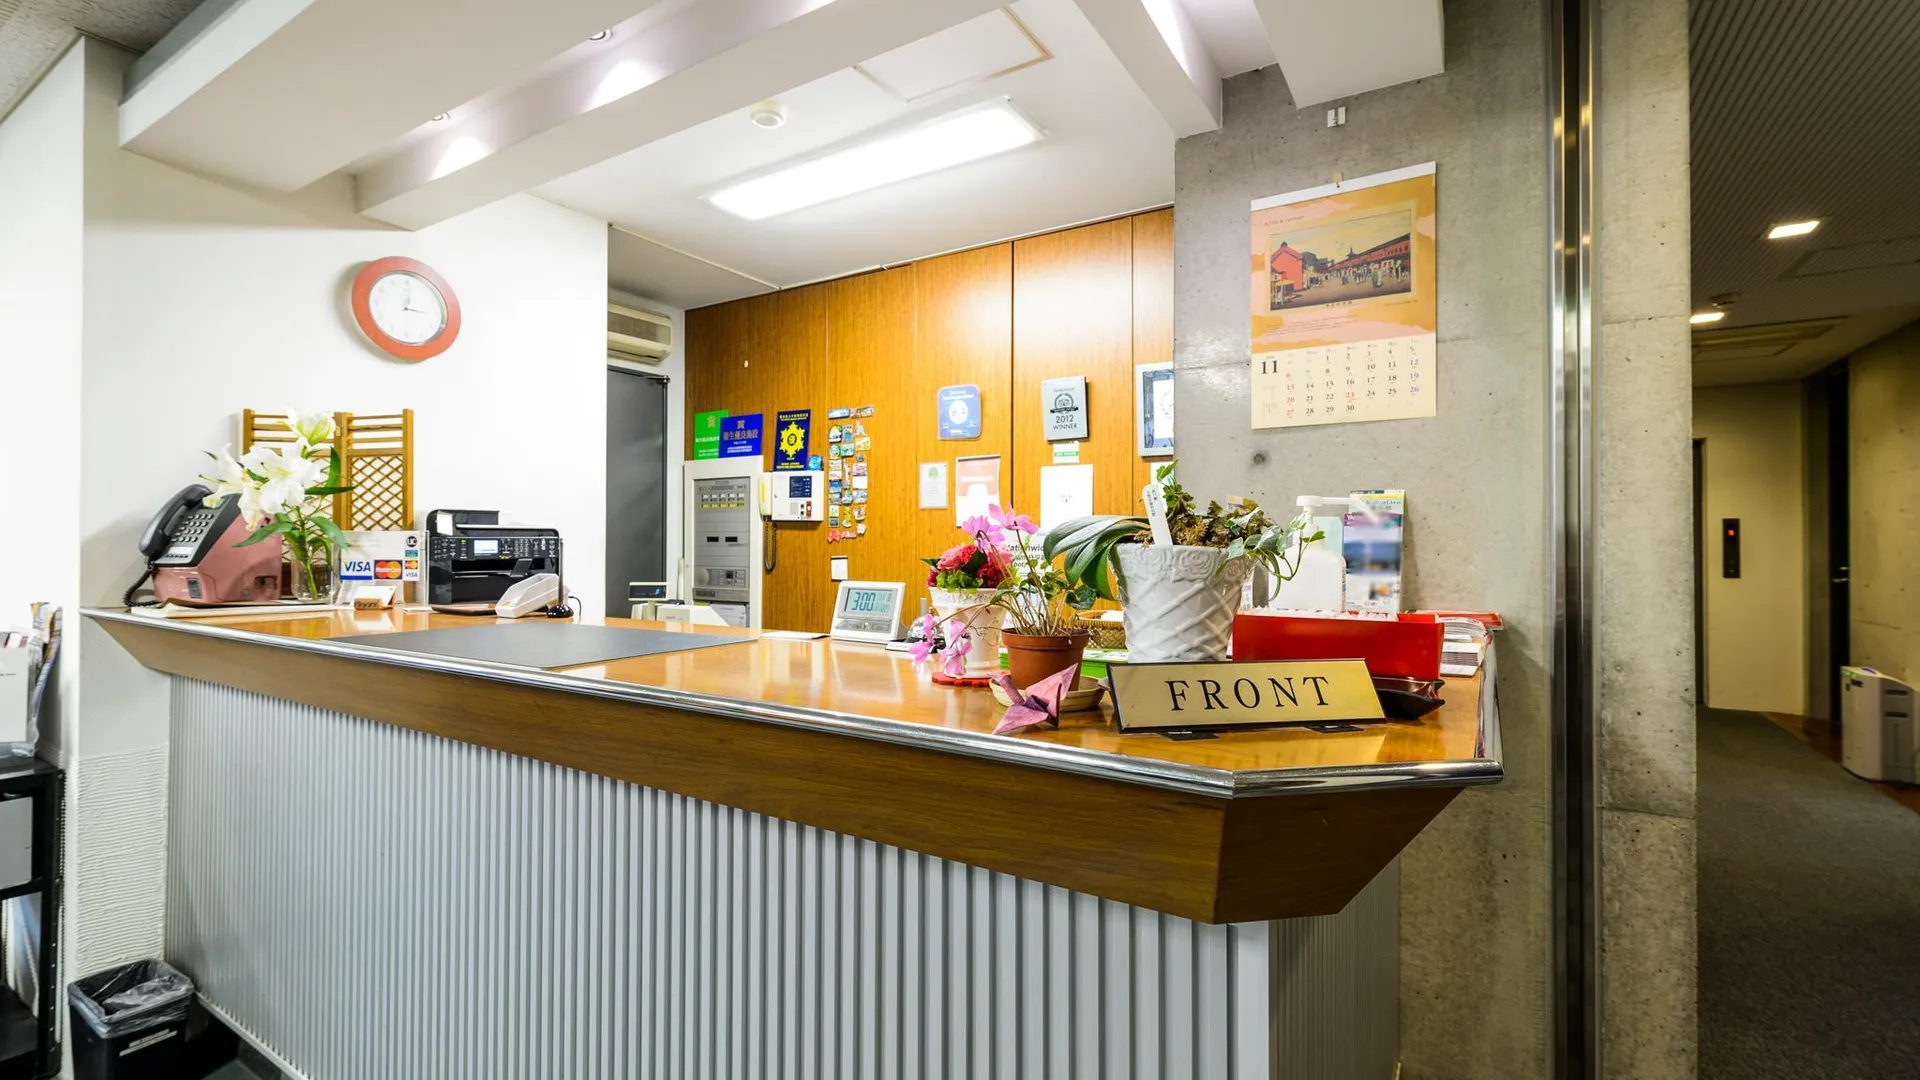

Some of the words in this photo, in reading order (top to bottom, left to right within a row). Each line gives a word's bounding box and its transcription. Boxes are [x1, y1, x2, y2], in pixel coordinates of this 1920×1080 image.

[1261, 360, 1278, 375] 11
[1286, 396, 1295, 404] 20
[1346, 404, 1355, 412] 30
[1055, 414, 1075, 424] 2012
[1052, 423, 1078, 431] WINNER
[344, 561, 371, 572] VISA
[1164, 676, 1330, 711] FRONT
